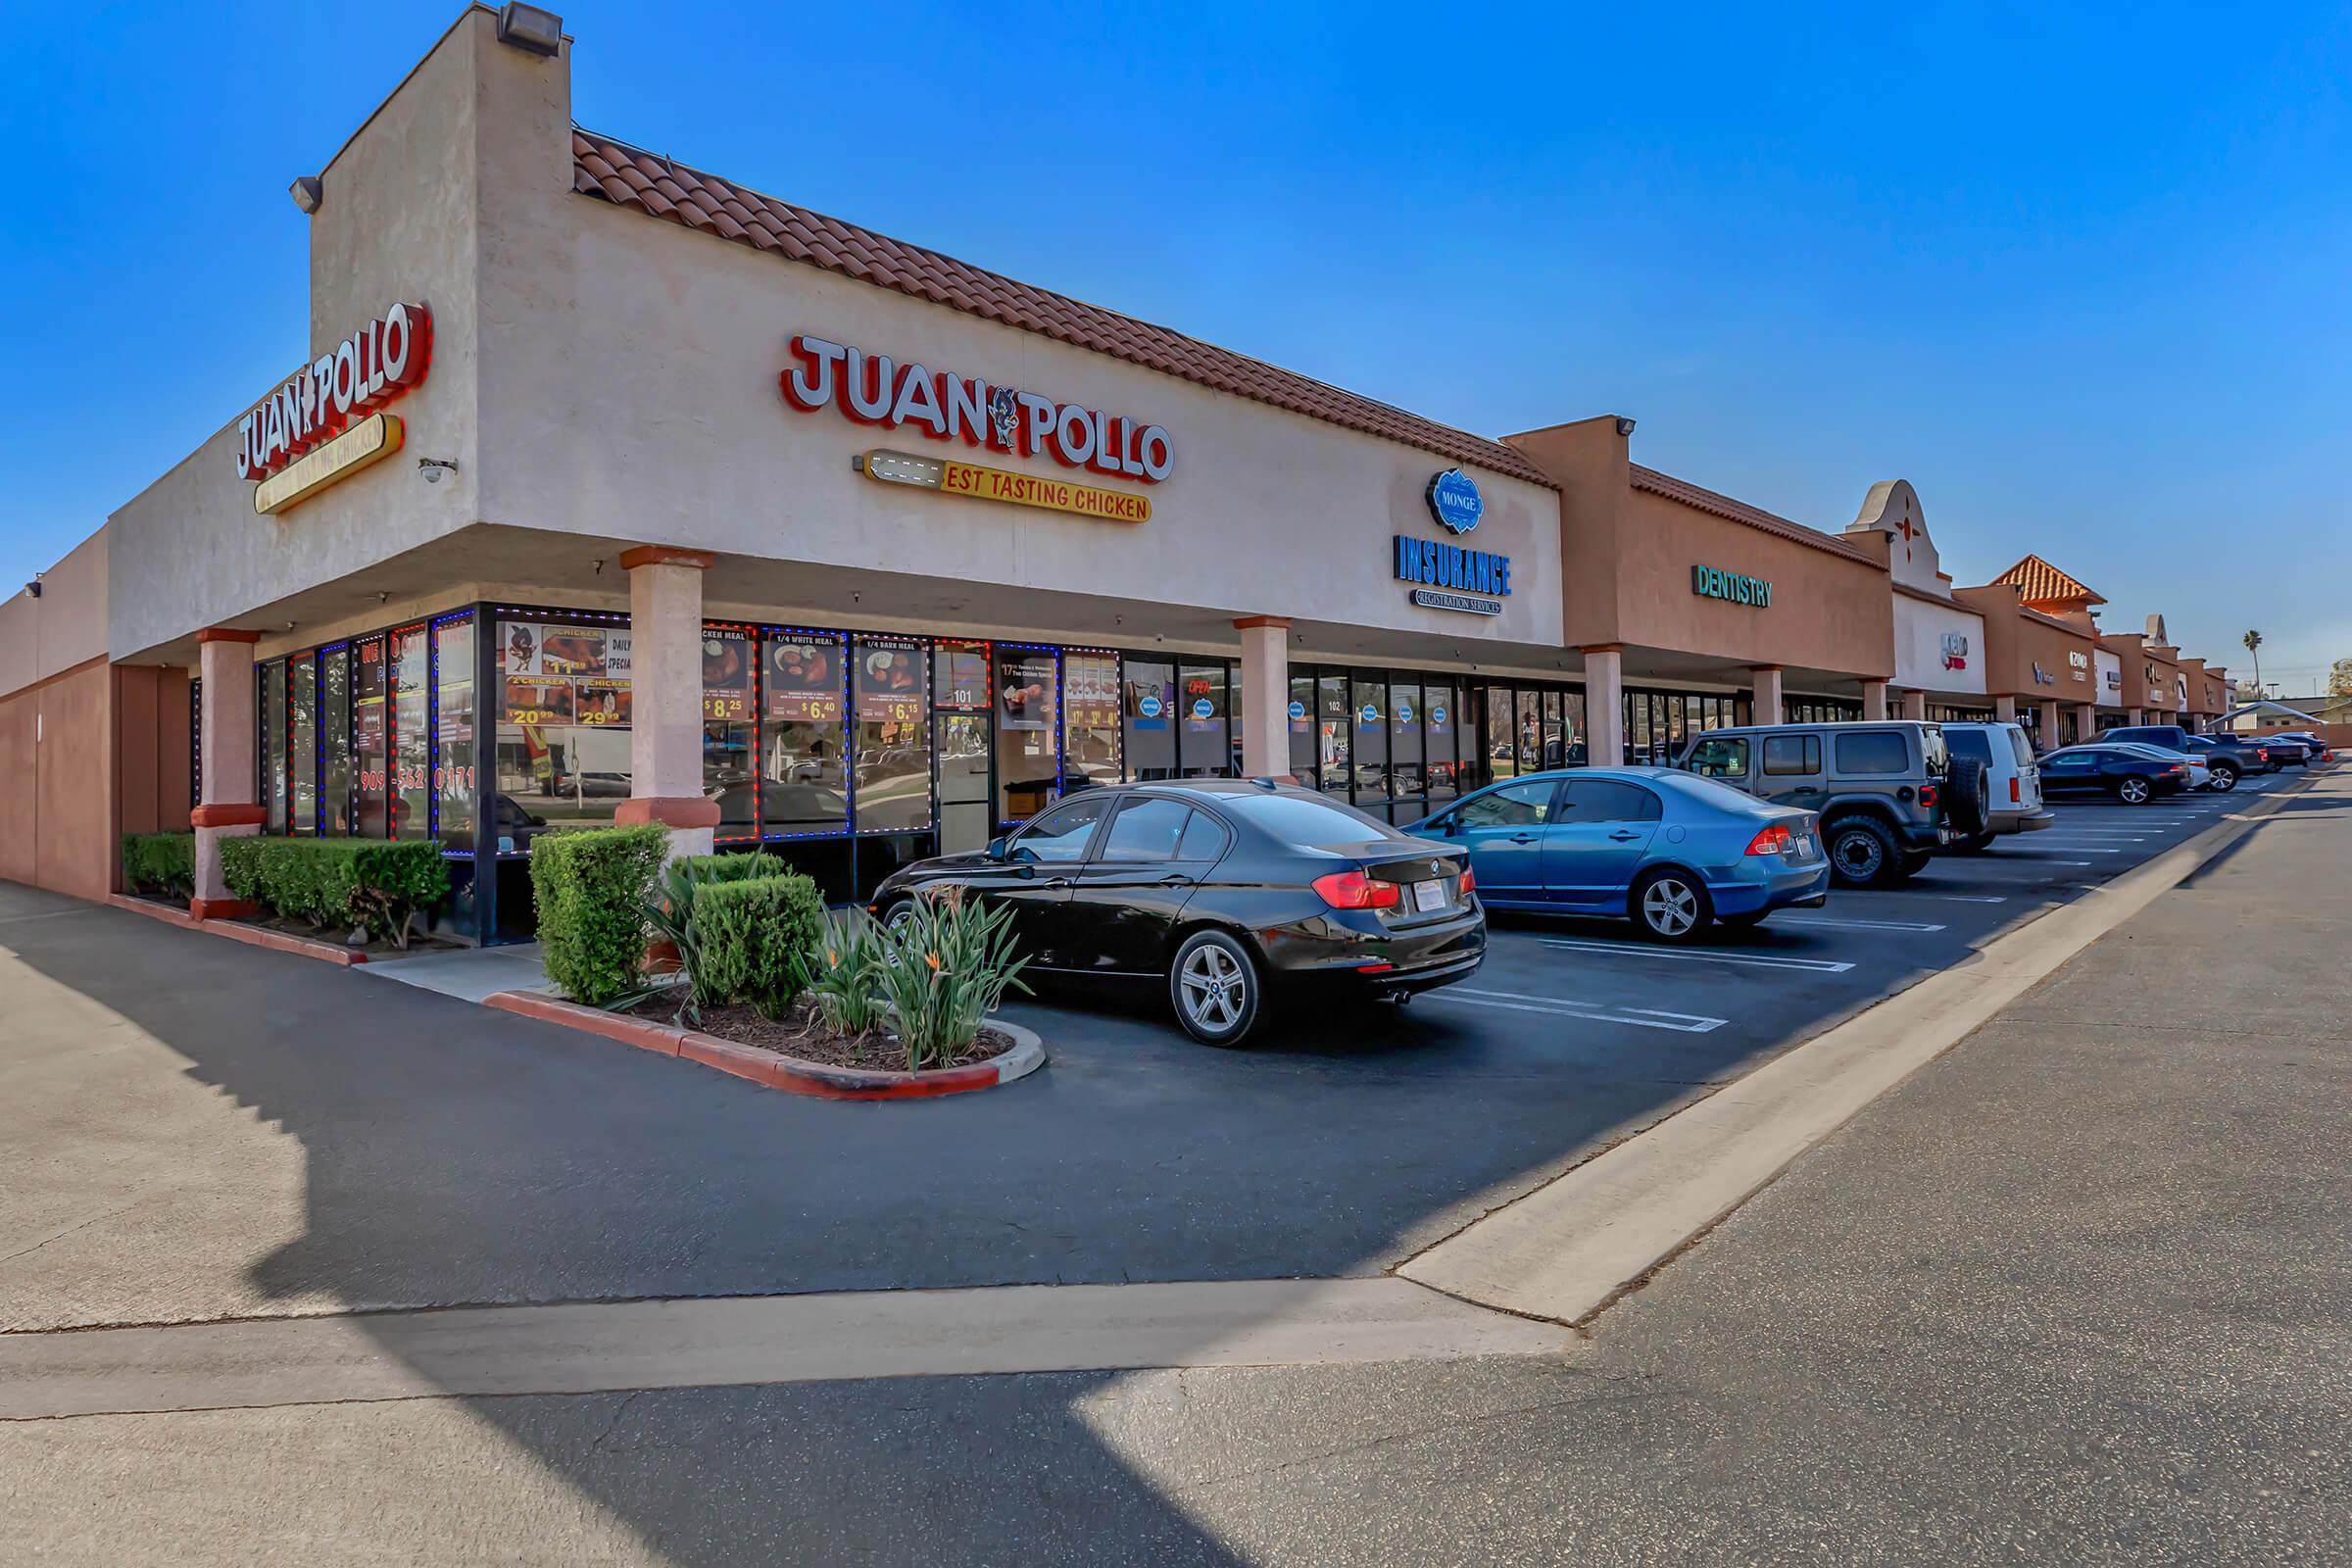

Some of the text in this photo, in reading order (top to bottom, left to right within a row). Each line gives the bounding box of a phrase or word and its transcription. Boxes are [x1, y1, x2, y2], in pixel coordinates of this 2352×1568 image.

[237, 302, 412, 480] JUAN POLLO
[790, 335, 1176, 482] JUAN POLLO
[942, 465, 1148, 519] EST TASTING CHICKEN
[1442, 490, 1477, 512] MONGE
[1397, 534, 1512, 596] INSURANCE
[1696, 564, 1773, 608] DENTISTRY
[1419, 592, 1500, 613] REGISTRATION SERVICES
[724, 632, 746, 641] MEAL
[777, 634, 834, 646] 1/4 WHITE MEAL
[867, 640, 879, 649] 1/4
[362, 642, 379, 664] WE
[954, 689, 971, 704] 101
[1188, 679, 1212, 695] OPEN
[1328, 701, 1341, 711] 102
[361, 766, 475, 792] 909-5620171
